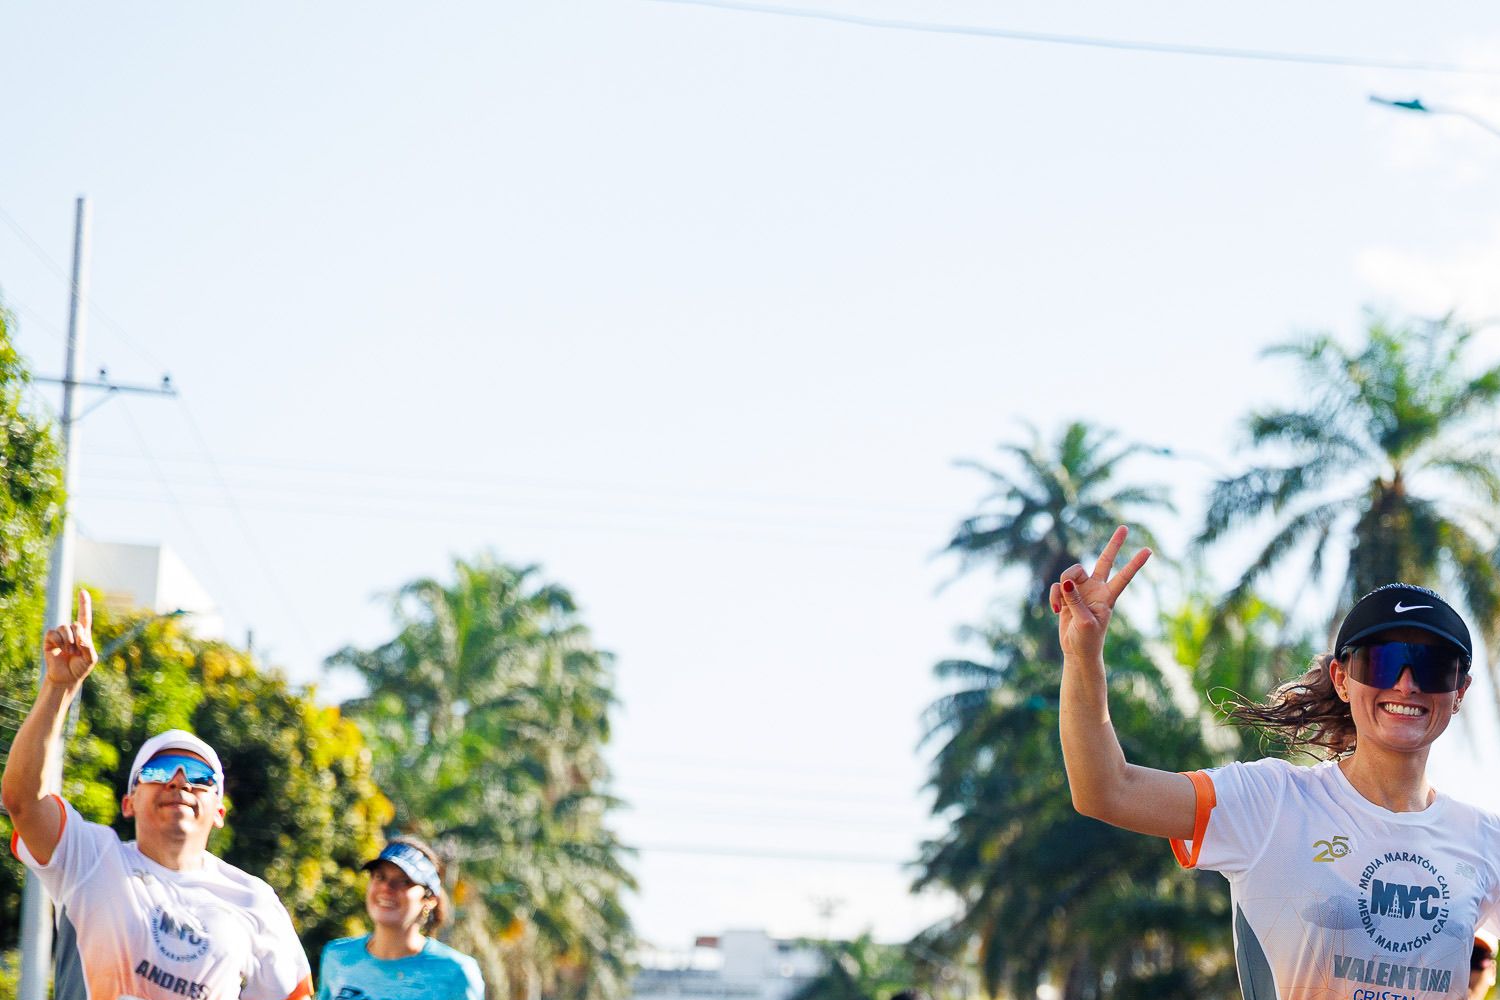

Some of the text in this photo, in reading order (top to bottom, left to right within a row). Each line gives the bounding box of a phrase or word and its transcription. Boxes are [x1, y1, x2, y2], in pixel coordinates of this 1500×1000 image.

[1312, 836, 1349, 862] 25
[1359, 858, 1384, 890] MEDIA
[1384, 852, 1437, 875] MARATÓN
[1437, 875, 1450, 900] CALI
[1358, 898, 1450, 952] MEDIA MARATÓN CALI
[135, 959, 210, 1000] ANDRES
[1334, 954, 1452, 993] VALENTINA
